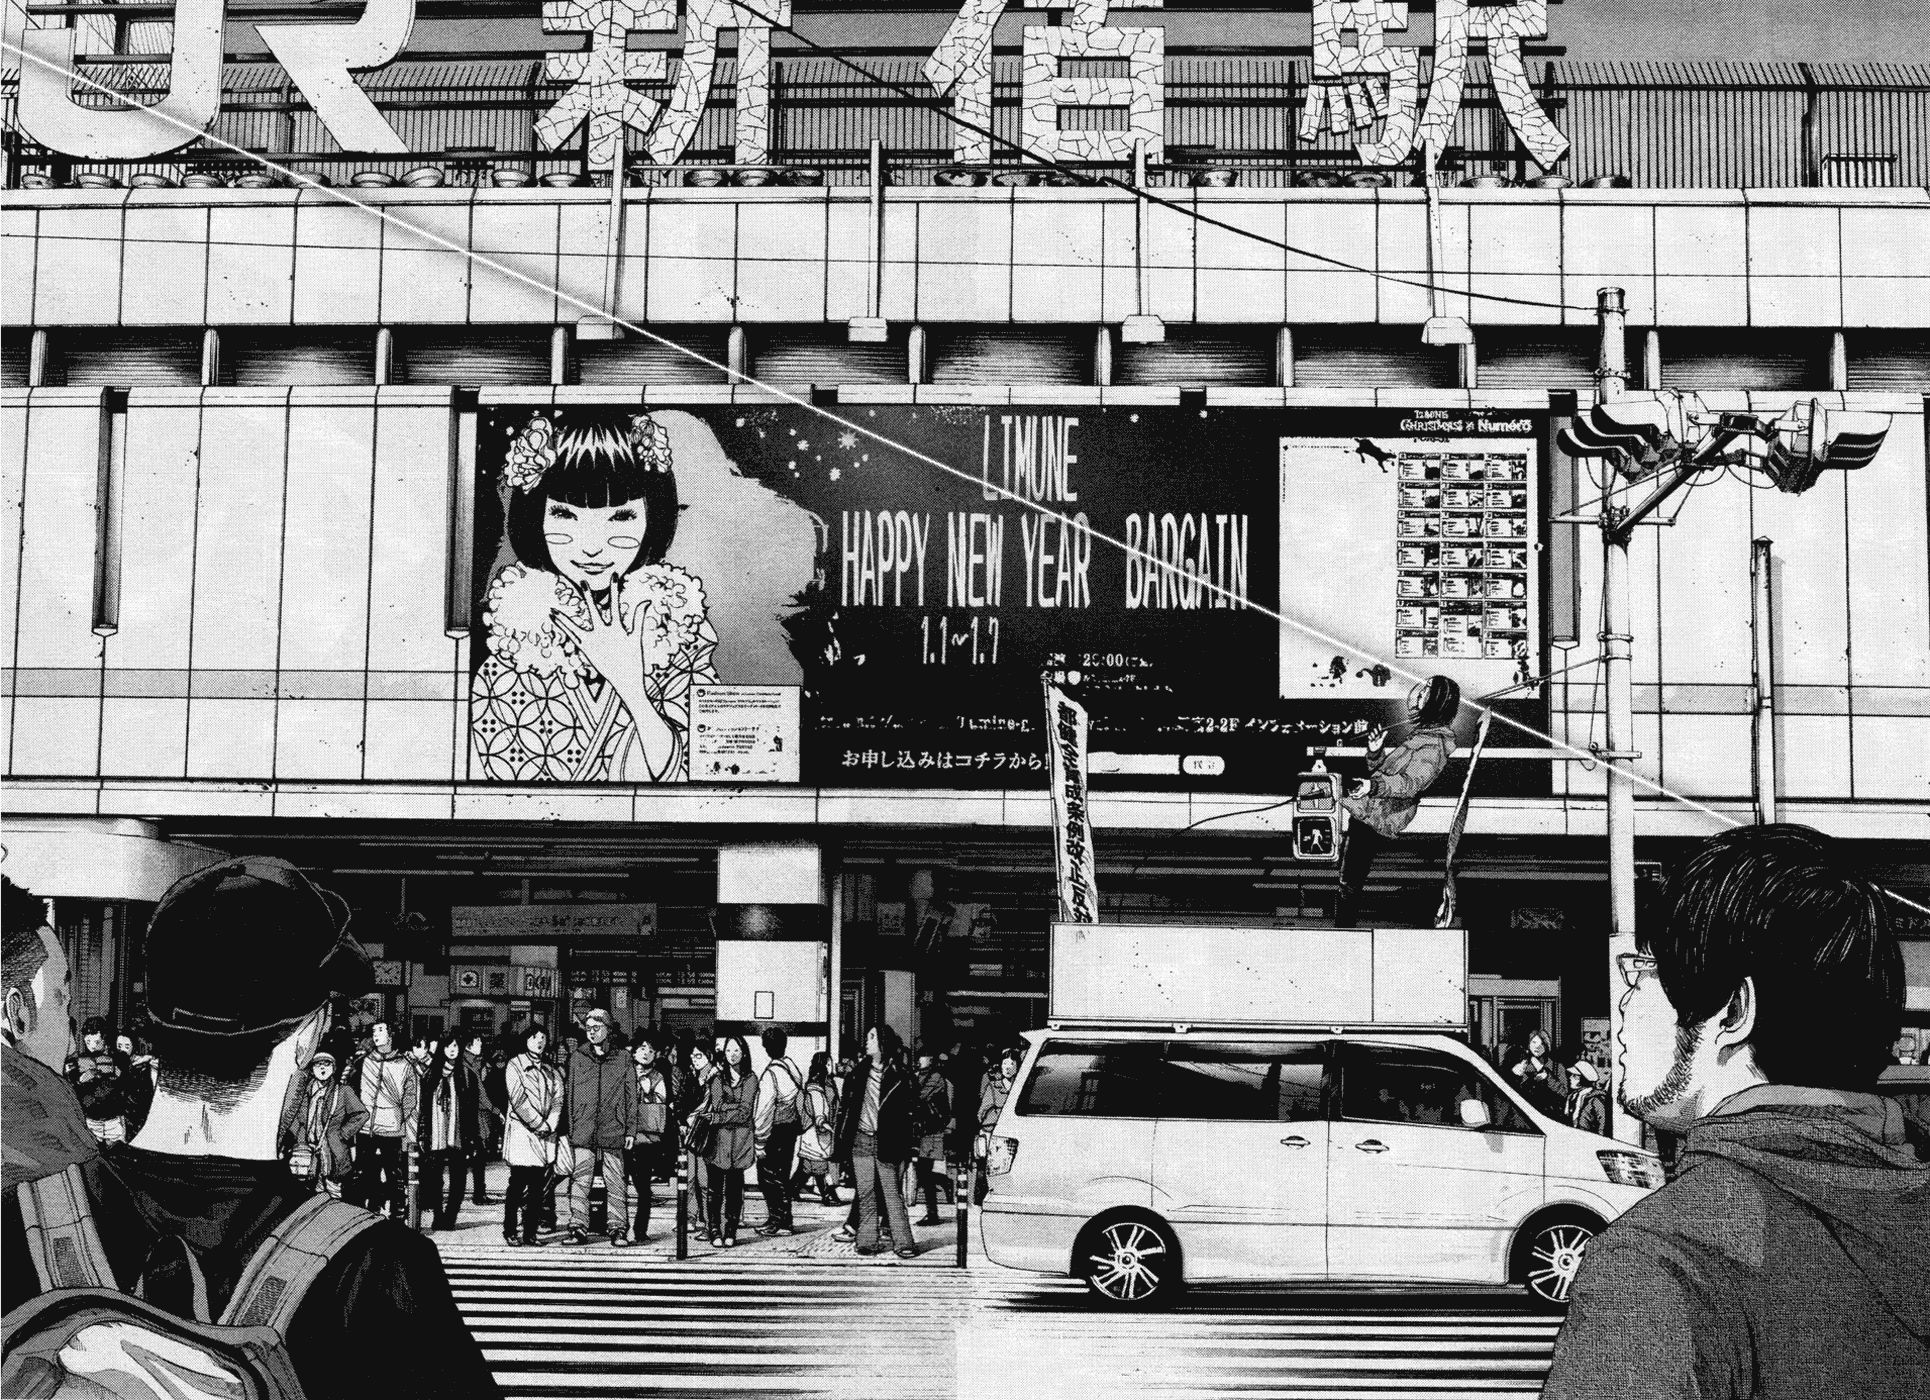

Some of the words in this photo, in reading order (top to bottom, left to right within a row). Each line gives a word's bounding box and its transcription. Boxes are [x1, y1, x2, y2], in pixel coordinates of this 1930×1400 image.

[982, 414, 1079, 502] LIMUNE
[841, 509, 930, 607] HAPPY
[947, 511, 1004, 608] NEW
[1021, 512, 1092, 608] YEAR
[1125, 512, 1248, 610] BARGAIN
